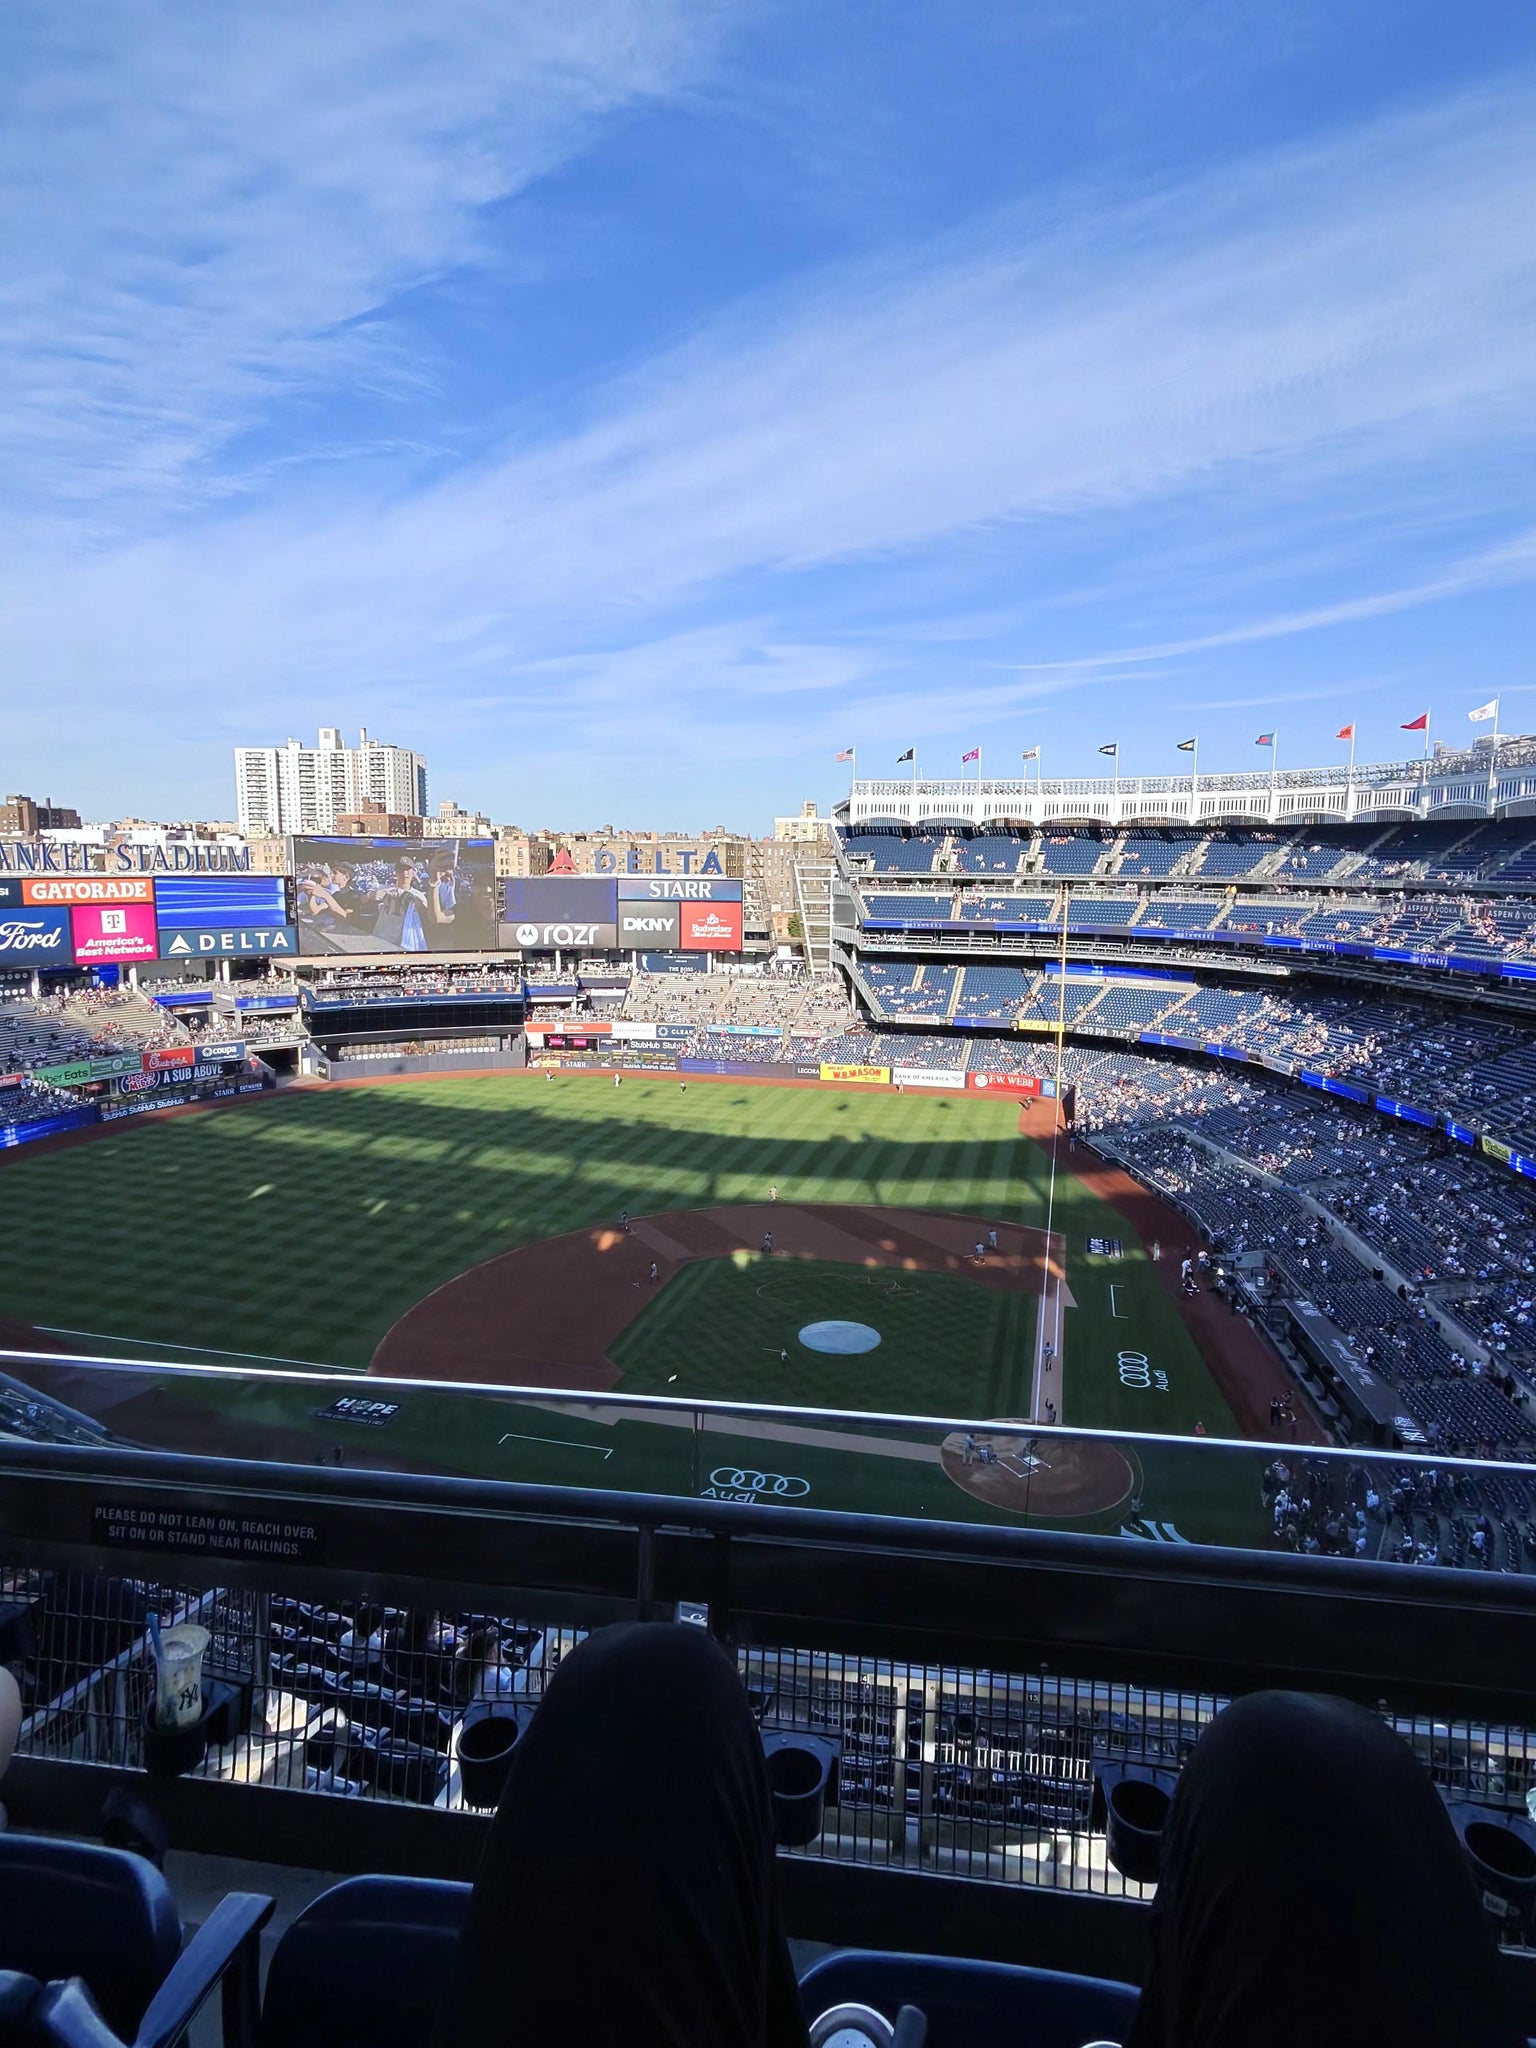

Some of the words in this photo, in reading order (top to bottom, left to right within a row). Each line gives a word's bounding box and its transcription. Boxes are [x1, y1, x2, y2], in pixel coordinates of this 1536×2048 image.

[0, 842, 98, 871] ANKEE
[116, 843, 251, 871] STADIUM
[594, 850, 723, 875] DELTA
[31, 882, 148, 900] GATORADE
[648, 881, 712, 899] STARR
[1407, 904, 1429, 912] ASPEN
[1435, 906, 1458, 914] VODKA
[1488, 910, 1513, 918] ASPEN
[623, 918, 675, 932] DKNY
[692, 923, 733, 933] Budweiser
[0, 922, 62, 950] Ford
[85, 936, 144, 948] America's
[199, 932, 289, 951] DELTA
[543, 925, 600, 945] razr
[76, 948, 103, 957] Best
[104, 945, 154, 956] Network
[1076, 1026, 1094, 1035] 6:39
[1095, 1027, 1107, 1036] PM
[212, 1046, 237, 1056] coupa
[630, 1041, 660, 1049] StubHub
[64, 1068, 89, 1080] Eats
[163, 1072, 171, 1083] A
[172, 1069, 192, 1082] SUB
[193, 1064, 224, 1079] ABOVE
[989, 1075, 1006, 1084] F.W.
[1007, 1077, 1034, 1087] WEBB
[214, 1088, 235, 1098] STARR
[129, 1103, 155, 1115] StubHub
[156, 1097, 184, 1109] StubHub
[1153, 1369, 1170, 1392] Audi
[335, 1397, 399, 1414] HOPE
[700, 1487, 757, 1504] Audi
[95, 1507, 137, 1522] PLEASE
[139, 1511, 155, 1524] DO
[158, 1513, 182, 1527] NOT
[185, 1516, 215, 1530] LEAN
[218, 1519, 239, 1533] ON,
[241, 1521, 280, 1535] REACH
[283, 1525, 318, 1541] OVER,
[108, 1525, 126, 1537] SIT
[129, 1527, 146, 1540] ON
[149, 1529, 164, 1542] OR
[167, 1531, 205, 1545] STAND
[209, 1535, 241, 1549] NEAR
[243, 1538, 302, 1556] RAILINGS.
